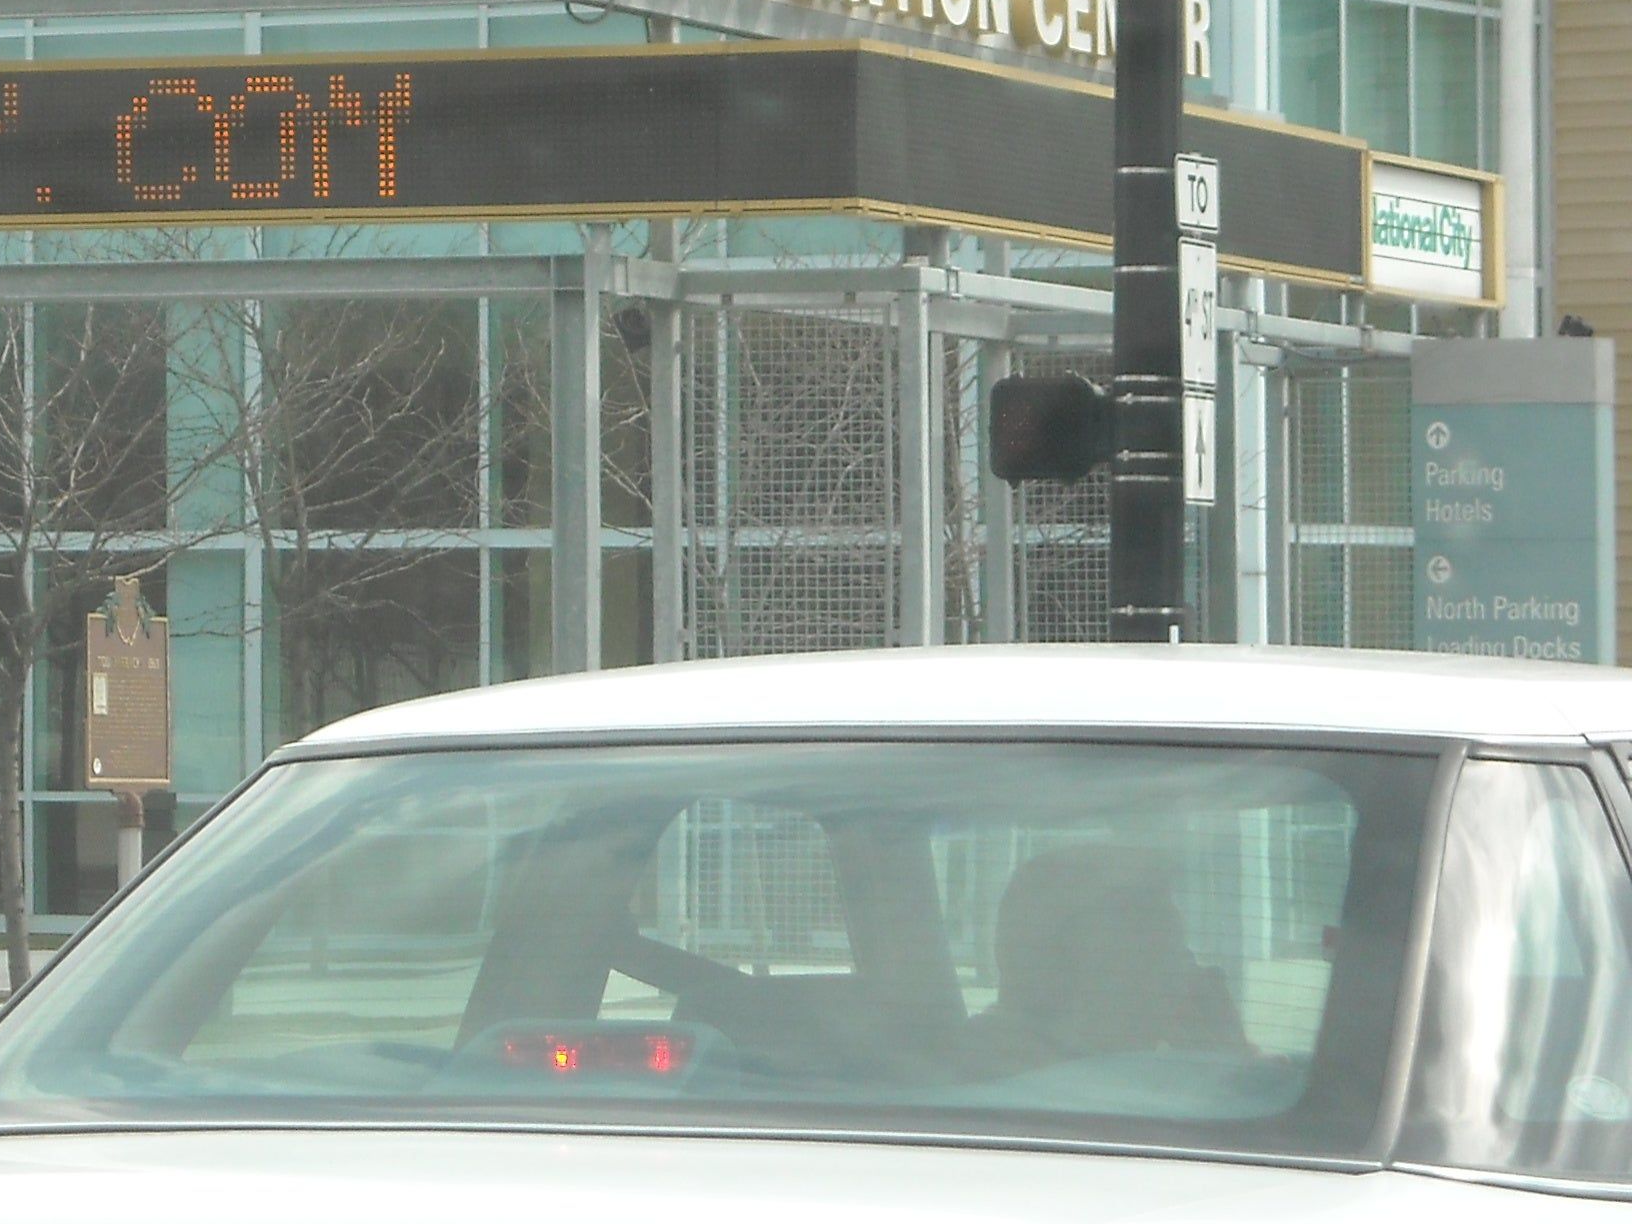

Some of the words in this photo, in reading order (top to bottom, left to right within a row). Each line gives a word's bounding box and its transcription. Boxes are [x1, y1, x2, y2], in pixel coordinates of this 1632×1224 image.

[1187, 174, 1209, 214] TO
[1439, 204, 1473, 270] City
[1425, 462, 1504, 491] Parking
[1425, 499, 1493, 522] Hotels
[1426, 596, 1485, 620] North
[1494, 595, 1580, 625] Parking
[1514, 636, 1582, 659] Docks
